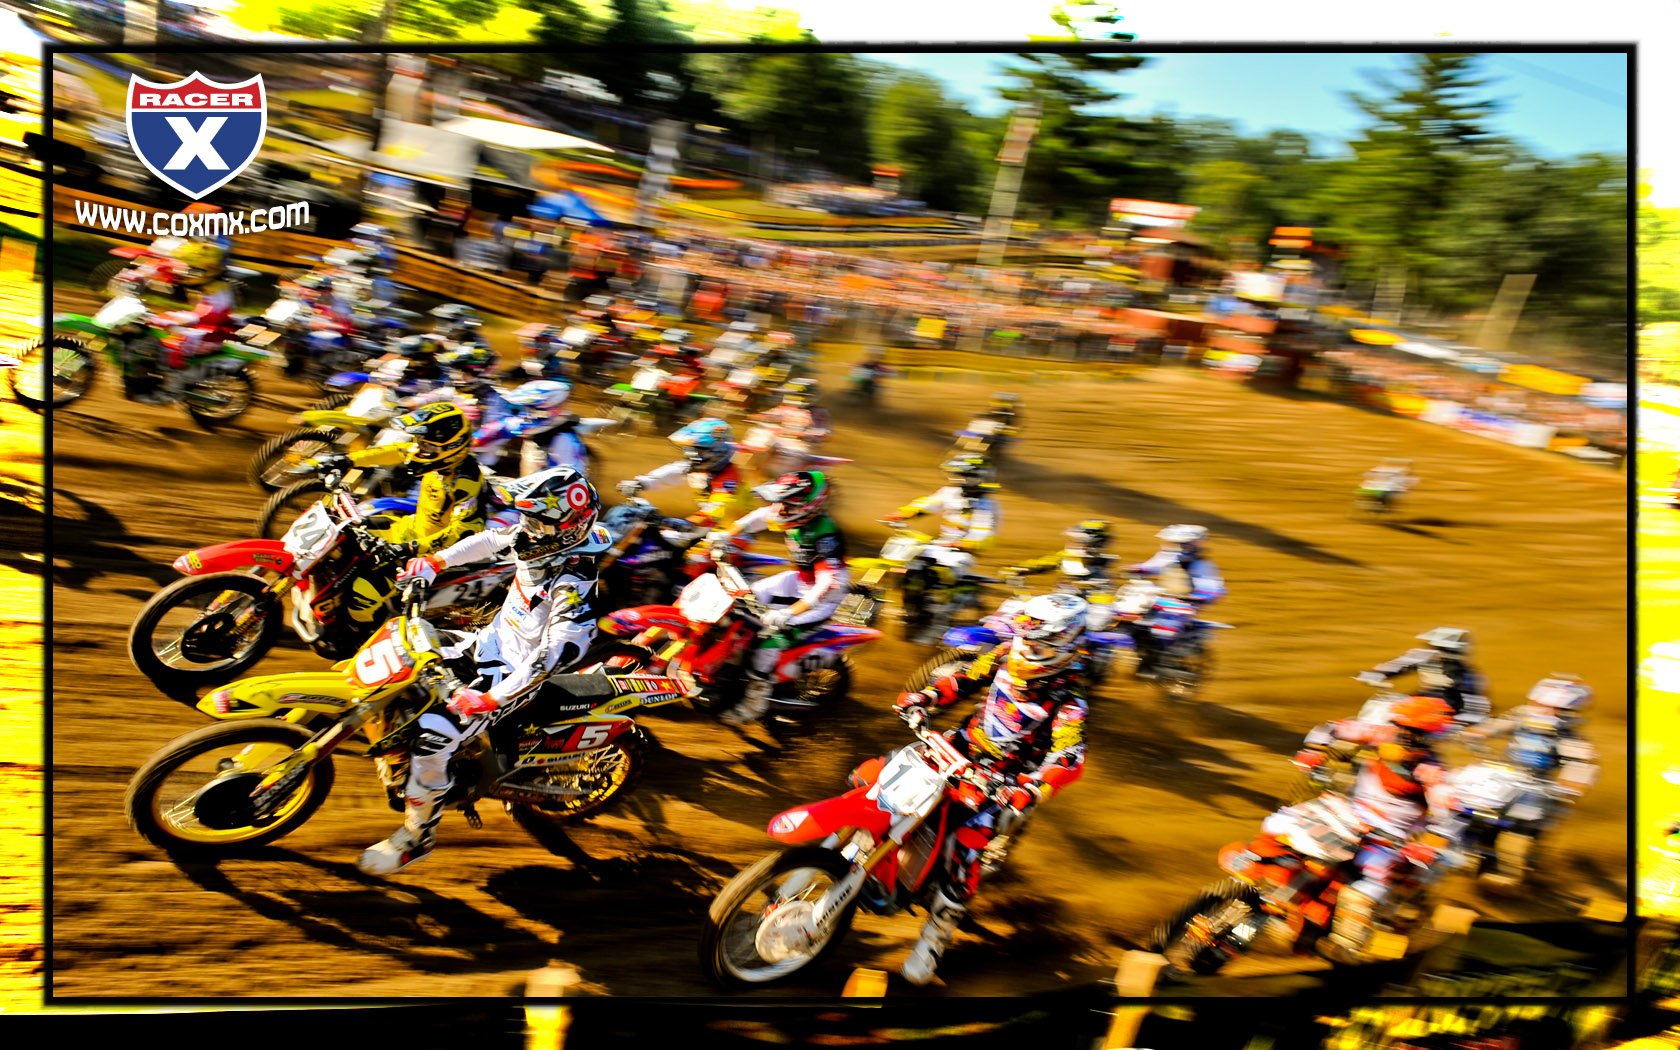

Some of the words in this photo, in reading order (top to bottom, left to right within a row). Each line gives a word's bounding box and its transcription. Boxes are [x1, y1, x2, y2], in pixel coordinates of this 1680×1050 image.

[292, 512, 329, 551] 24
[452, 580, 485, 604] 24
[355, 638, 403, 685] 5
[559, 703, 591, 712] SUZUKI
[640, 693, 678, 706] DUNLOP
[577, 724, 613, 750] 5
